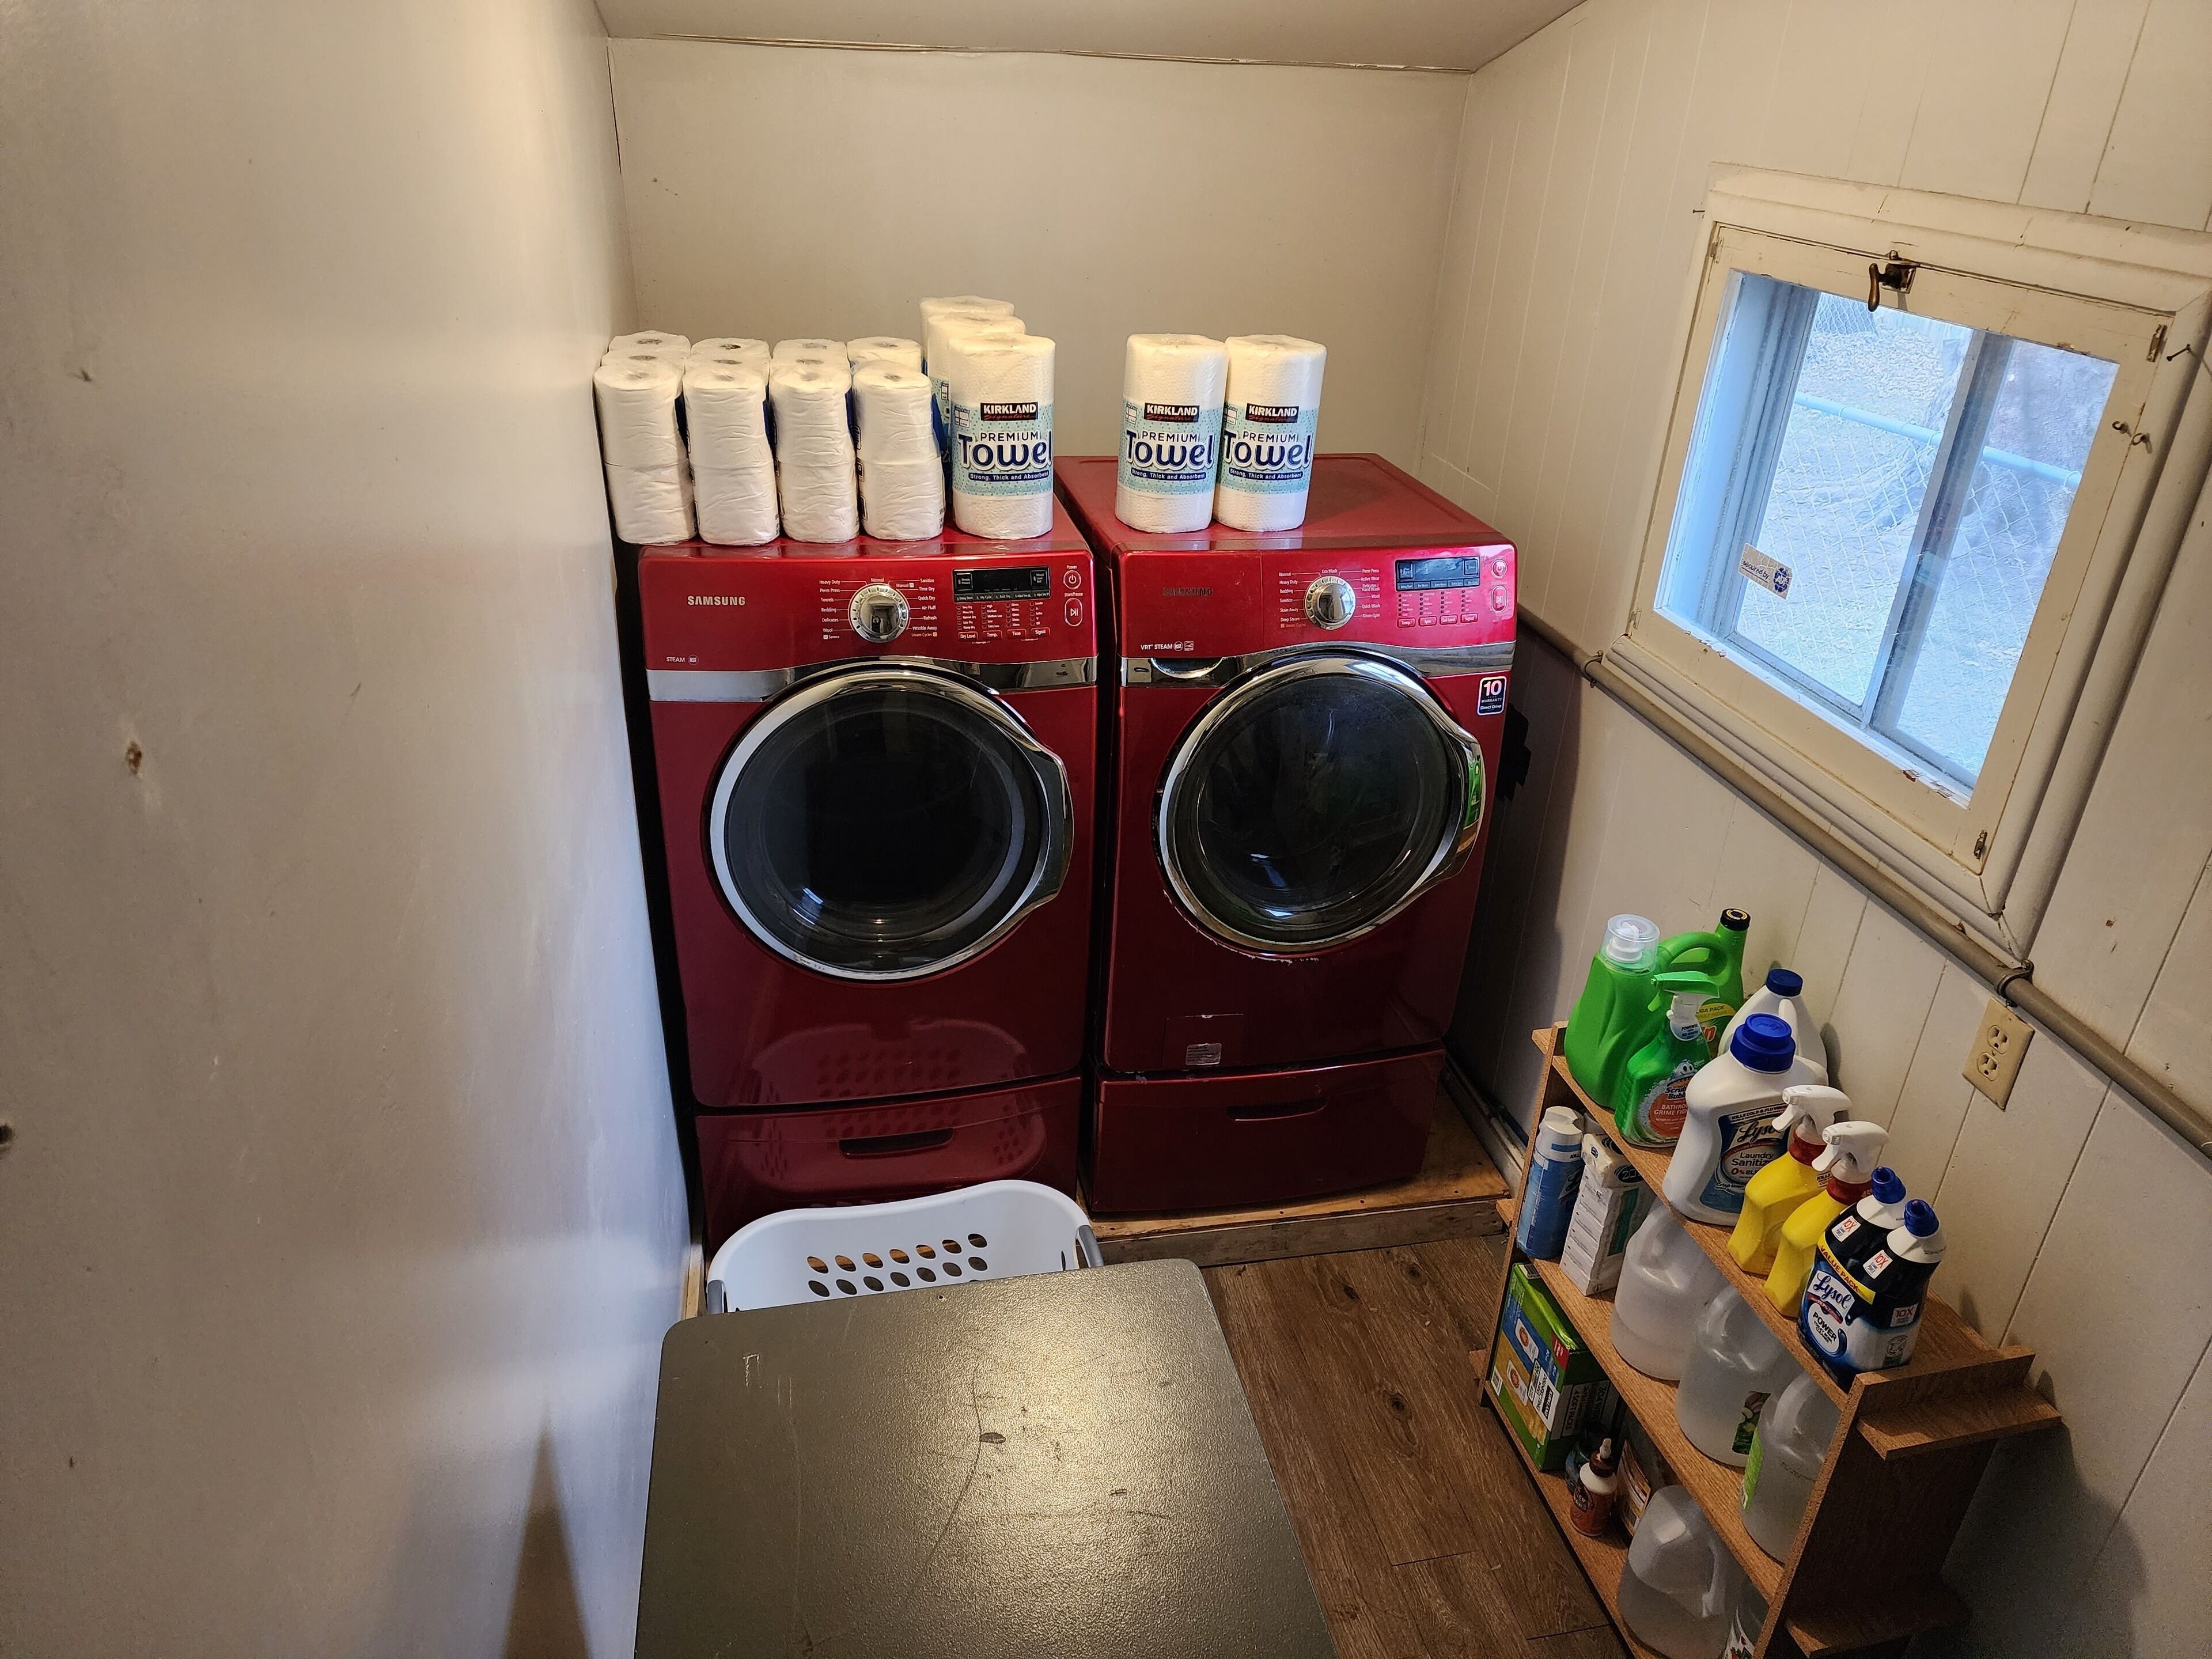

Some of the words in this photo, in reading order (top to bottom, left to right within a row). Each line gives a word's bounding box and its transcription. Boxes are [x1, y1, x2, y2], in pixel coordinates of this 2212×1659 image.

[983, 404, 1036, 414] KIRKLAND
[1147, 404, 1198, 416] KIRKLAND
[1249, 405, 1297, 417] KIRKLAND
[980, 432, 1039, 442] PREMIUM
[1142, 431, 1197, 442] PREMIUM
[1243, 431, 1296, 442] PREMIUM
[958, 430, 1053, 467] Towel
[1127, 431, 1214, 465] Towel
[1223, 431, 1312, 465] Towel
[1024, 471, 1049, 479] Absorbent
[1131, 469, 1148, 478] Strong,
[1150, 471, 1165, 479] Thick
[1230, 469, 1247, 478] Strong,
[1743, 560, 1763, 575] secured
[1763, 570, 1770, 580] by
[1162, 588, 1213, 596] SAMSUNG
[687, 596, 745, 605] SAMSUNG
[1484, 680, 1502, 696] 10
[1843, 1218, 1857, 1233] 10X
[1874, 1253, 1889, 1269] 10X
[1820, 1245, 1840, 1273] VALUE
[1840, 1271, 1859, 1292] PACK
[1813, 1273, 1852, 1310] Lysol
[1896, 1308, 1914, 1318] 10X
[1813, 1312, 1837, 1342] POWER
[1544, 1389, 1552, 1418] KIRKLAND
